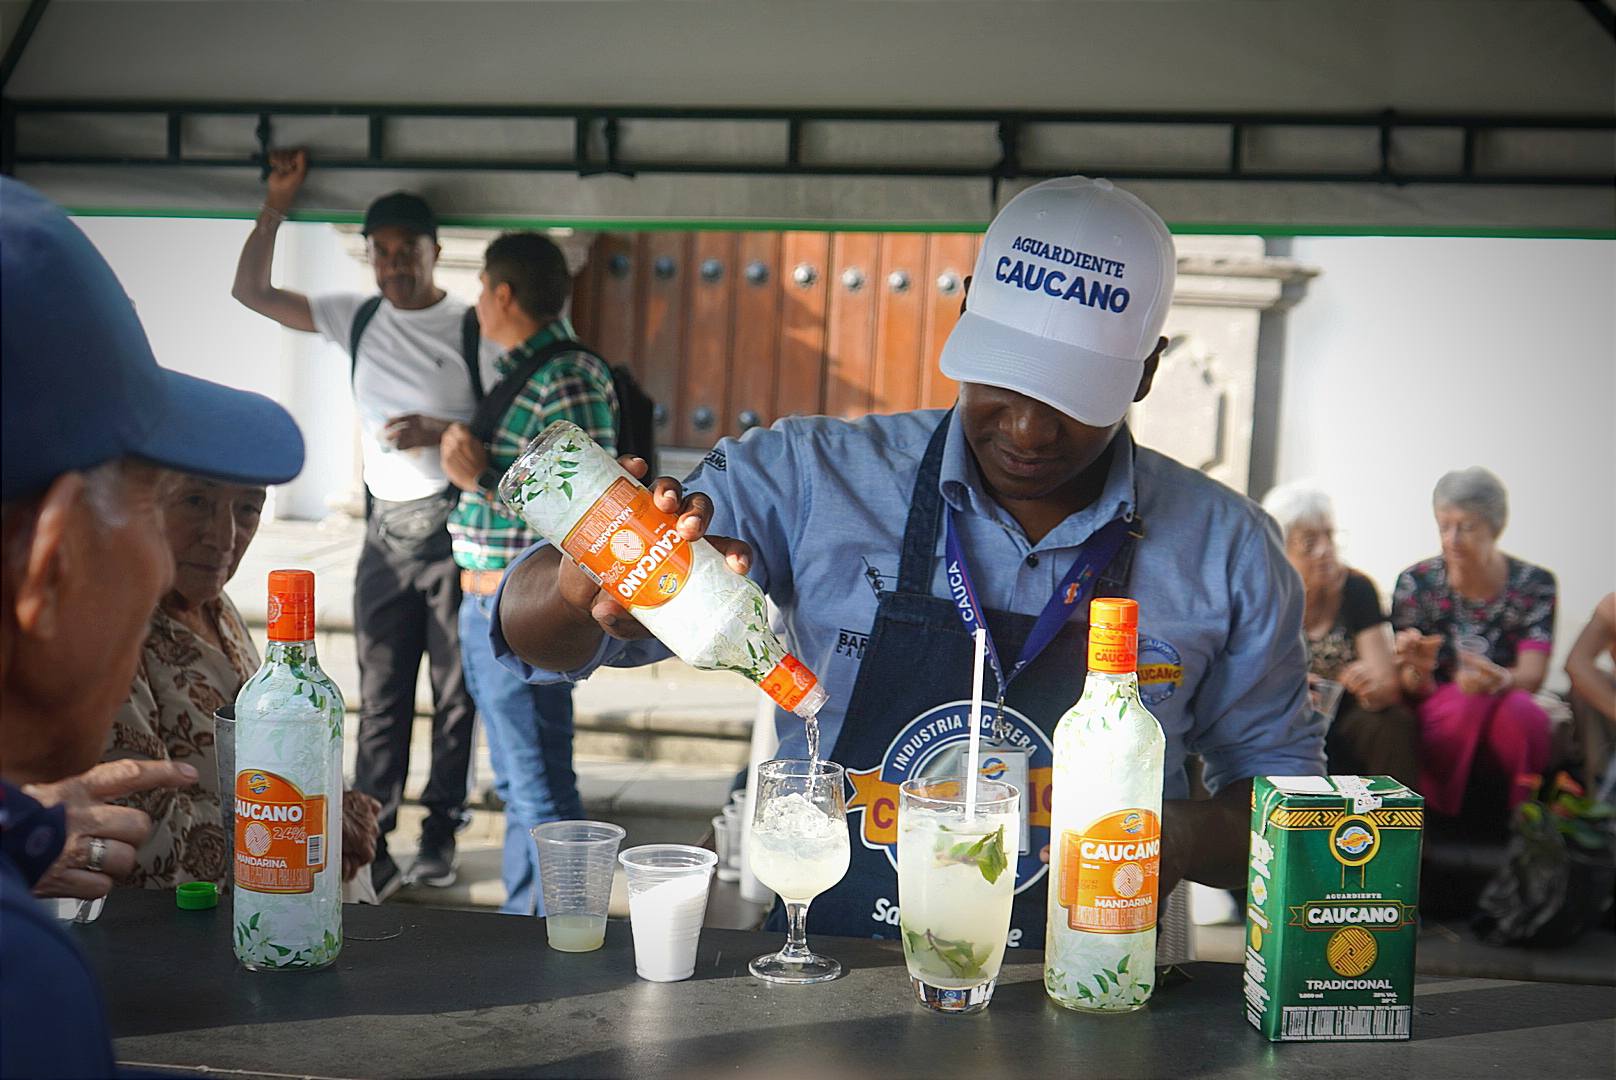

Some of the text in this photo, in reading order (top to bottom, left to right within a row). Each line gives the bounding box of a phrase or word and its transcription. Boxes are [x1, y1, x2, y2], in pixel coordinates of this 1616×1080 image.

[1012, 236, 1125, 279] AGUARDIENTE
[995, 256, 1130, 313] CAUCANO
[588, 506, 634, 554] MANDARINA
[617, 529, 682, 598] CAUCANO
[948, 560, 975, 622] CAUCA
[892, 714, 963, 772] INDUSTRIA
[234, 799, 303, 822] AUCANO
[236, 852, 288, 869] MANDARINA
[1080, 839, 1159, 861] CAUCANO
[1095, 896, 1153, 909] MANDARINA
[1307, 906, 1399, 924] CAUCANO
[1306, 979, 1393, 991] TRADICIONAL
